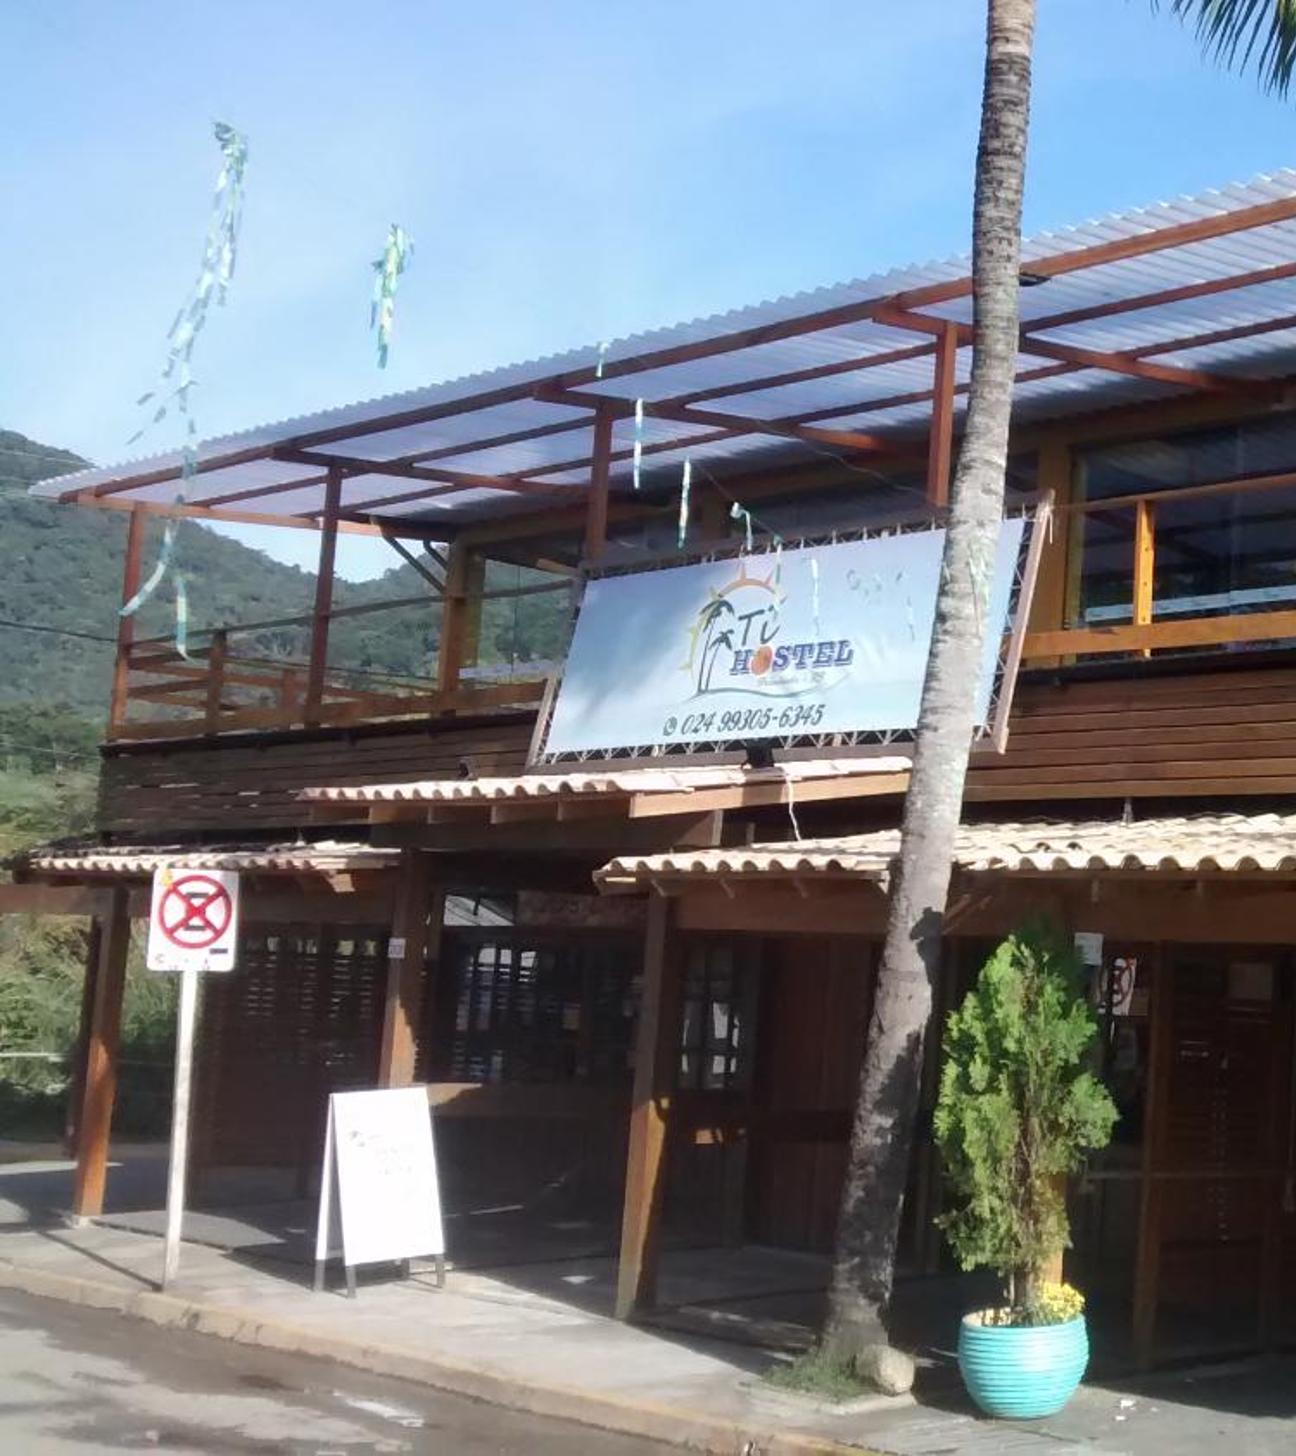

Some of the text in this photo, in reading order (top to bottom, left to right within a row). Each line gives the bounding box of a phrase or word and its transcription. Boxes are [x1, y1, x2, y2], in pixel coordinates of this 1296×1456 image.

[730, 640, 853, 675] HOSTEL
[681, 703, 826, 735] 024 99305-6345
